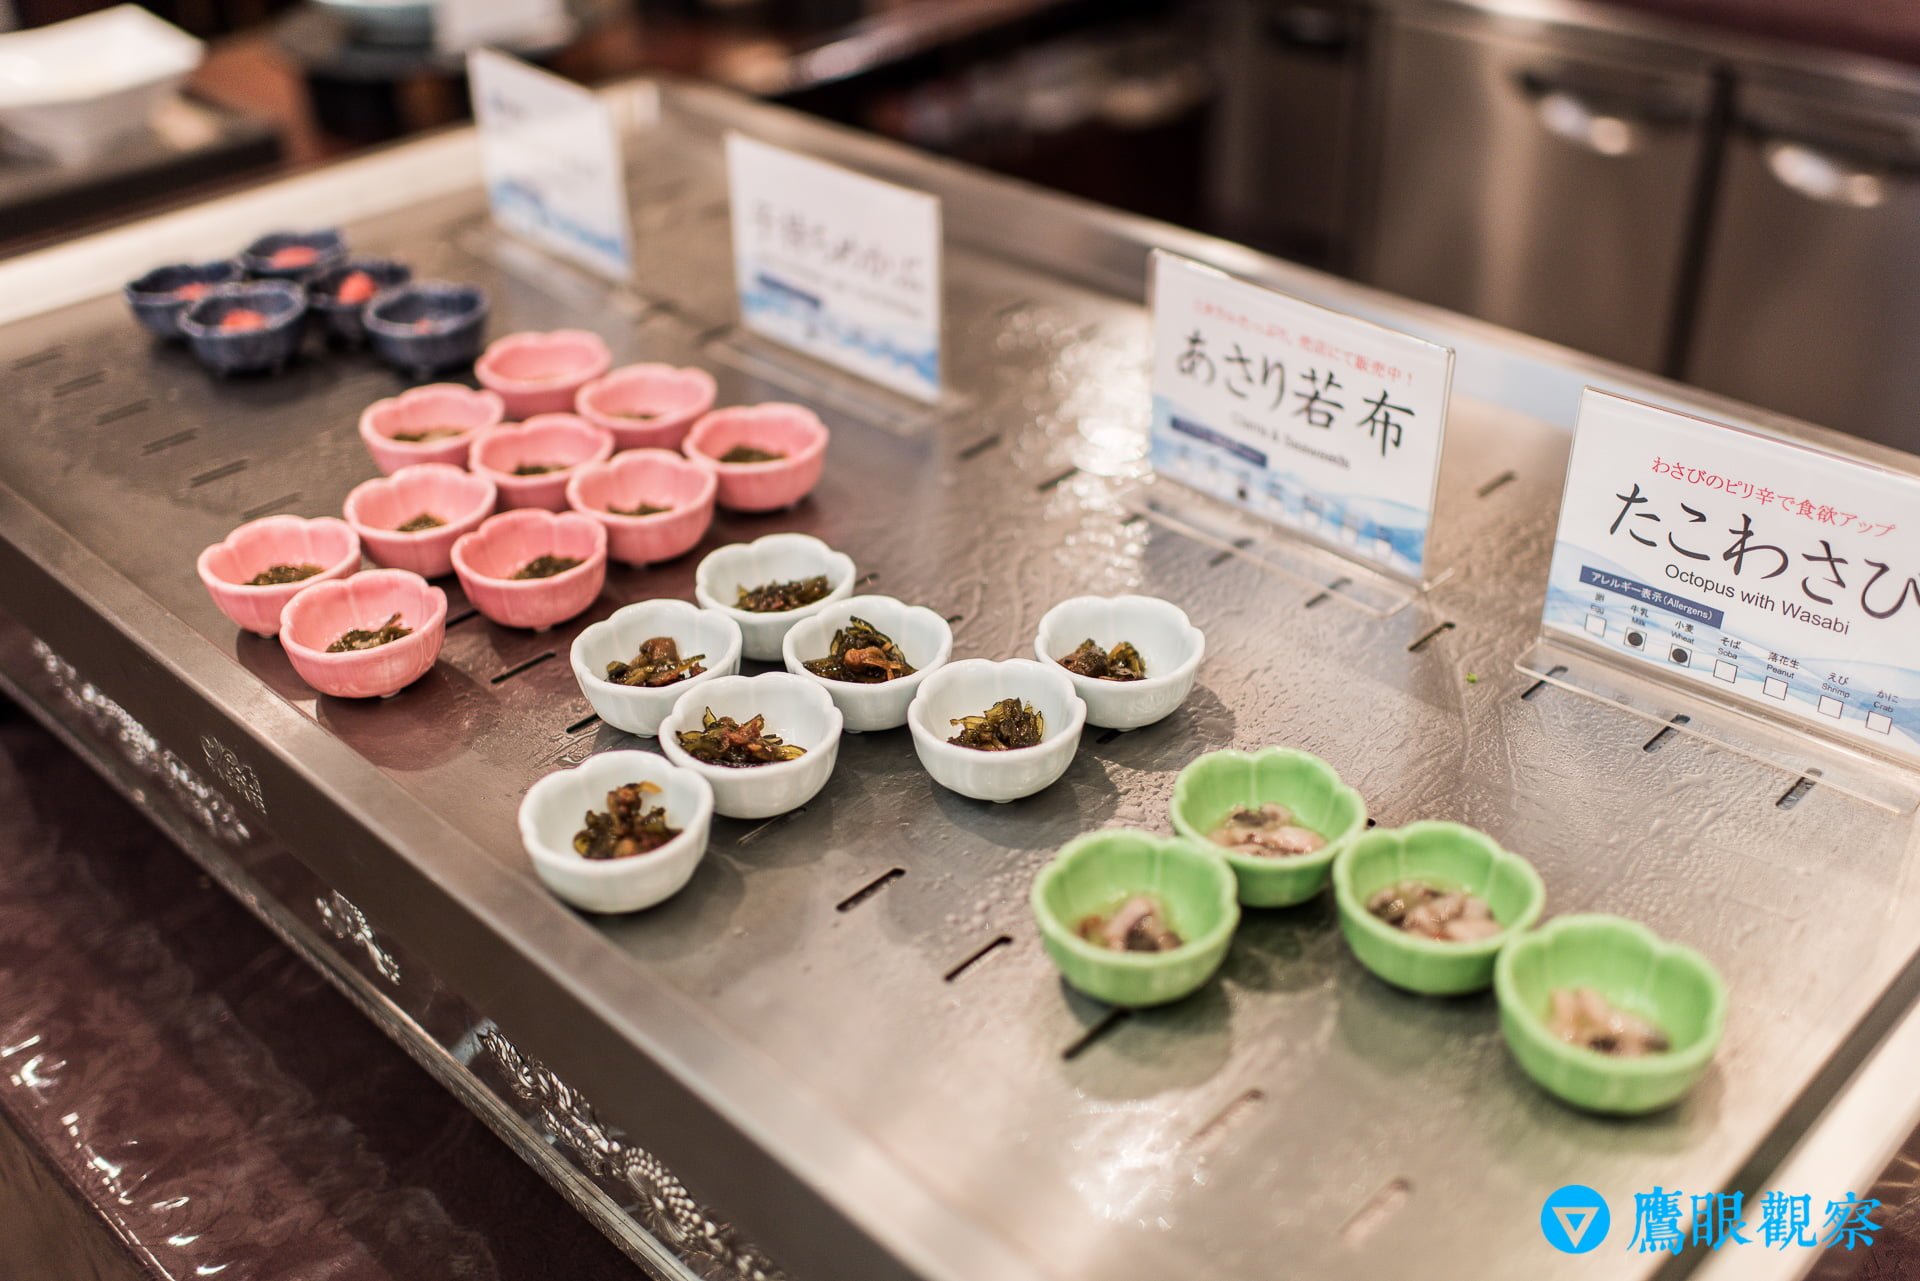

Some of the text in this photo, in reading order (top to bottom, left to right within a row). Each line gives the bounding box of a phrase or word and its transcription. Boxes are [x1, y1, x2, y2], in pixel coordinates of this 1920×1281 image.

[1176, 328, 1415, 457] あさり若布
[1652, 456, 1896, 537] わさびのピリ辛で食欲アップ
[1665, 563, 1850, 635] Octopus with Wasabi
[1630, 604, 1649, 618] 牛乳
[1675, 620, 1695, 634] 小麦
[1720, 636, 1742, 650] そば
[1768, 651, 1800, 670] 落花生
[1828, 672, 1849, 686] えび
[1876, 689, 1899, 705] かに
[1671, 630, 1695, 645] Wheat
[1718, 647, 1738, 660] Soba
[1766, 663, 1795, 680] Peanut
[1821, 682, 1850, 699] Shrimp
[1873, 700, 1894, 713] Crab
